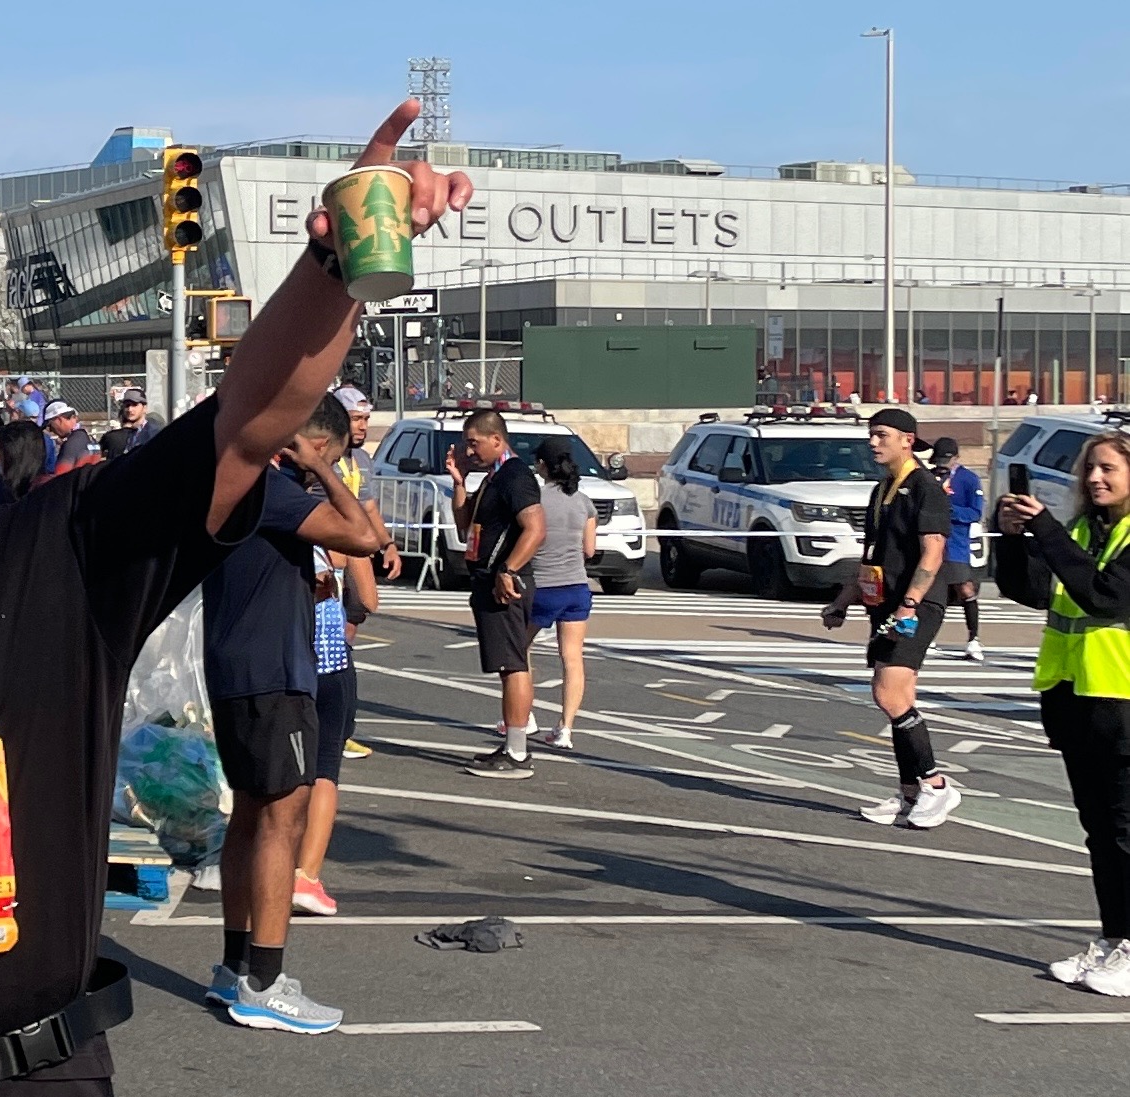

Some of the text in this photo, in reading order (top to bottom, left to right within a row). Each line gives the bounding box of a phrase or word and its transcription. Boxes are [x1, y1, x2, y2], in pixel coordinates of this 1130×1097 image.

[508, 202, 742, 248] OUTLETS
[403, 296, 428, 307] WAY
[6, 881, 13, 893] 1
[266, 997, 299, 1017] HOKA
